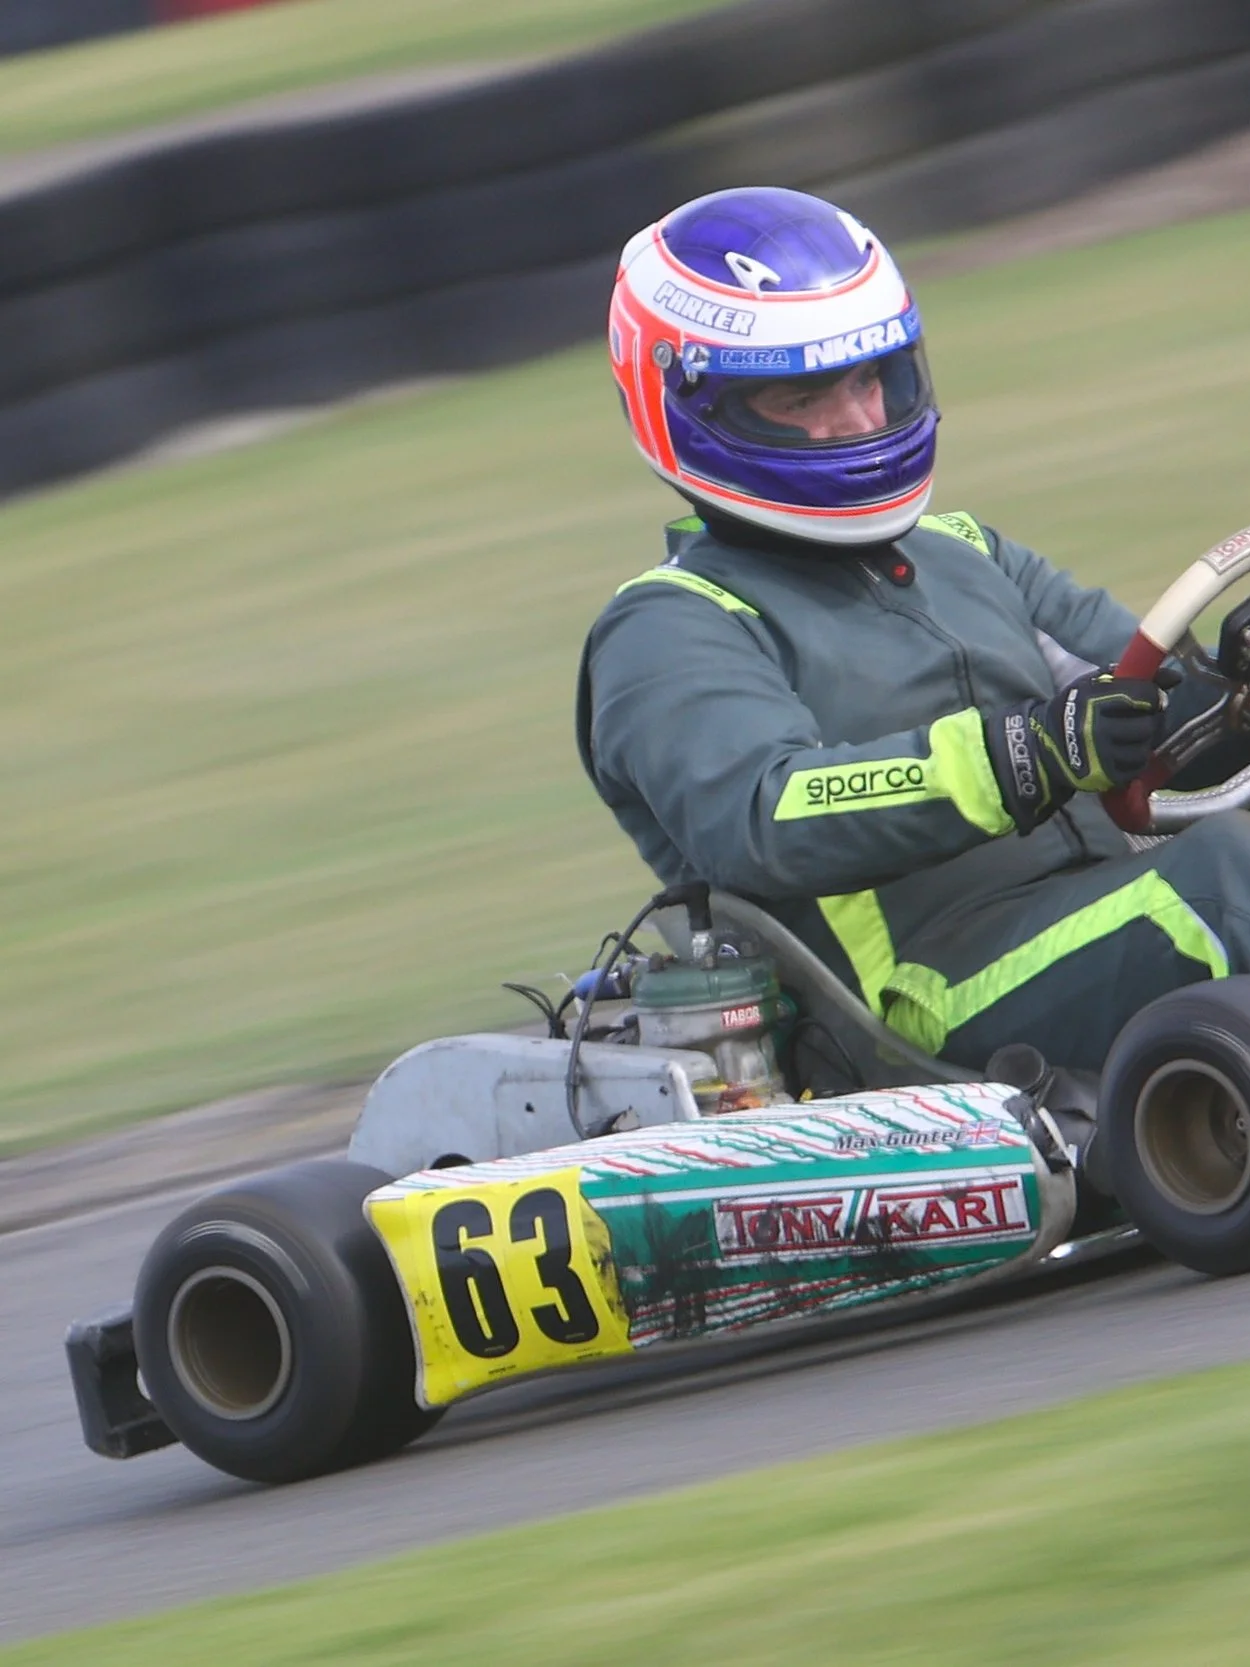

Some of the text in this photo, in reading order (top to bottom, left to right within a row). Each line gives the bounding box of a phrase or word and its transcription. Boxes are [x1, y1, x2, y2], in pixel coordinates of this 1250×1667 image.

[653, 280, 756, 337] PARKER
[720, 349, 789, 365] NKRA
[803, 319, 908, 371] NKRA
[1005, 714, 1036, 796] sparco
[806, 764, 926, 805] sparco
[722, 1006, 760, 1027] TABOR
[835, 1129, 965, 1150] Max Gunter
[717, 1181, 1022, 1250] TONY KART
[431, 1187, 600, 1359] 63
